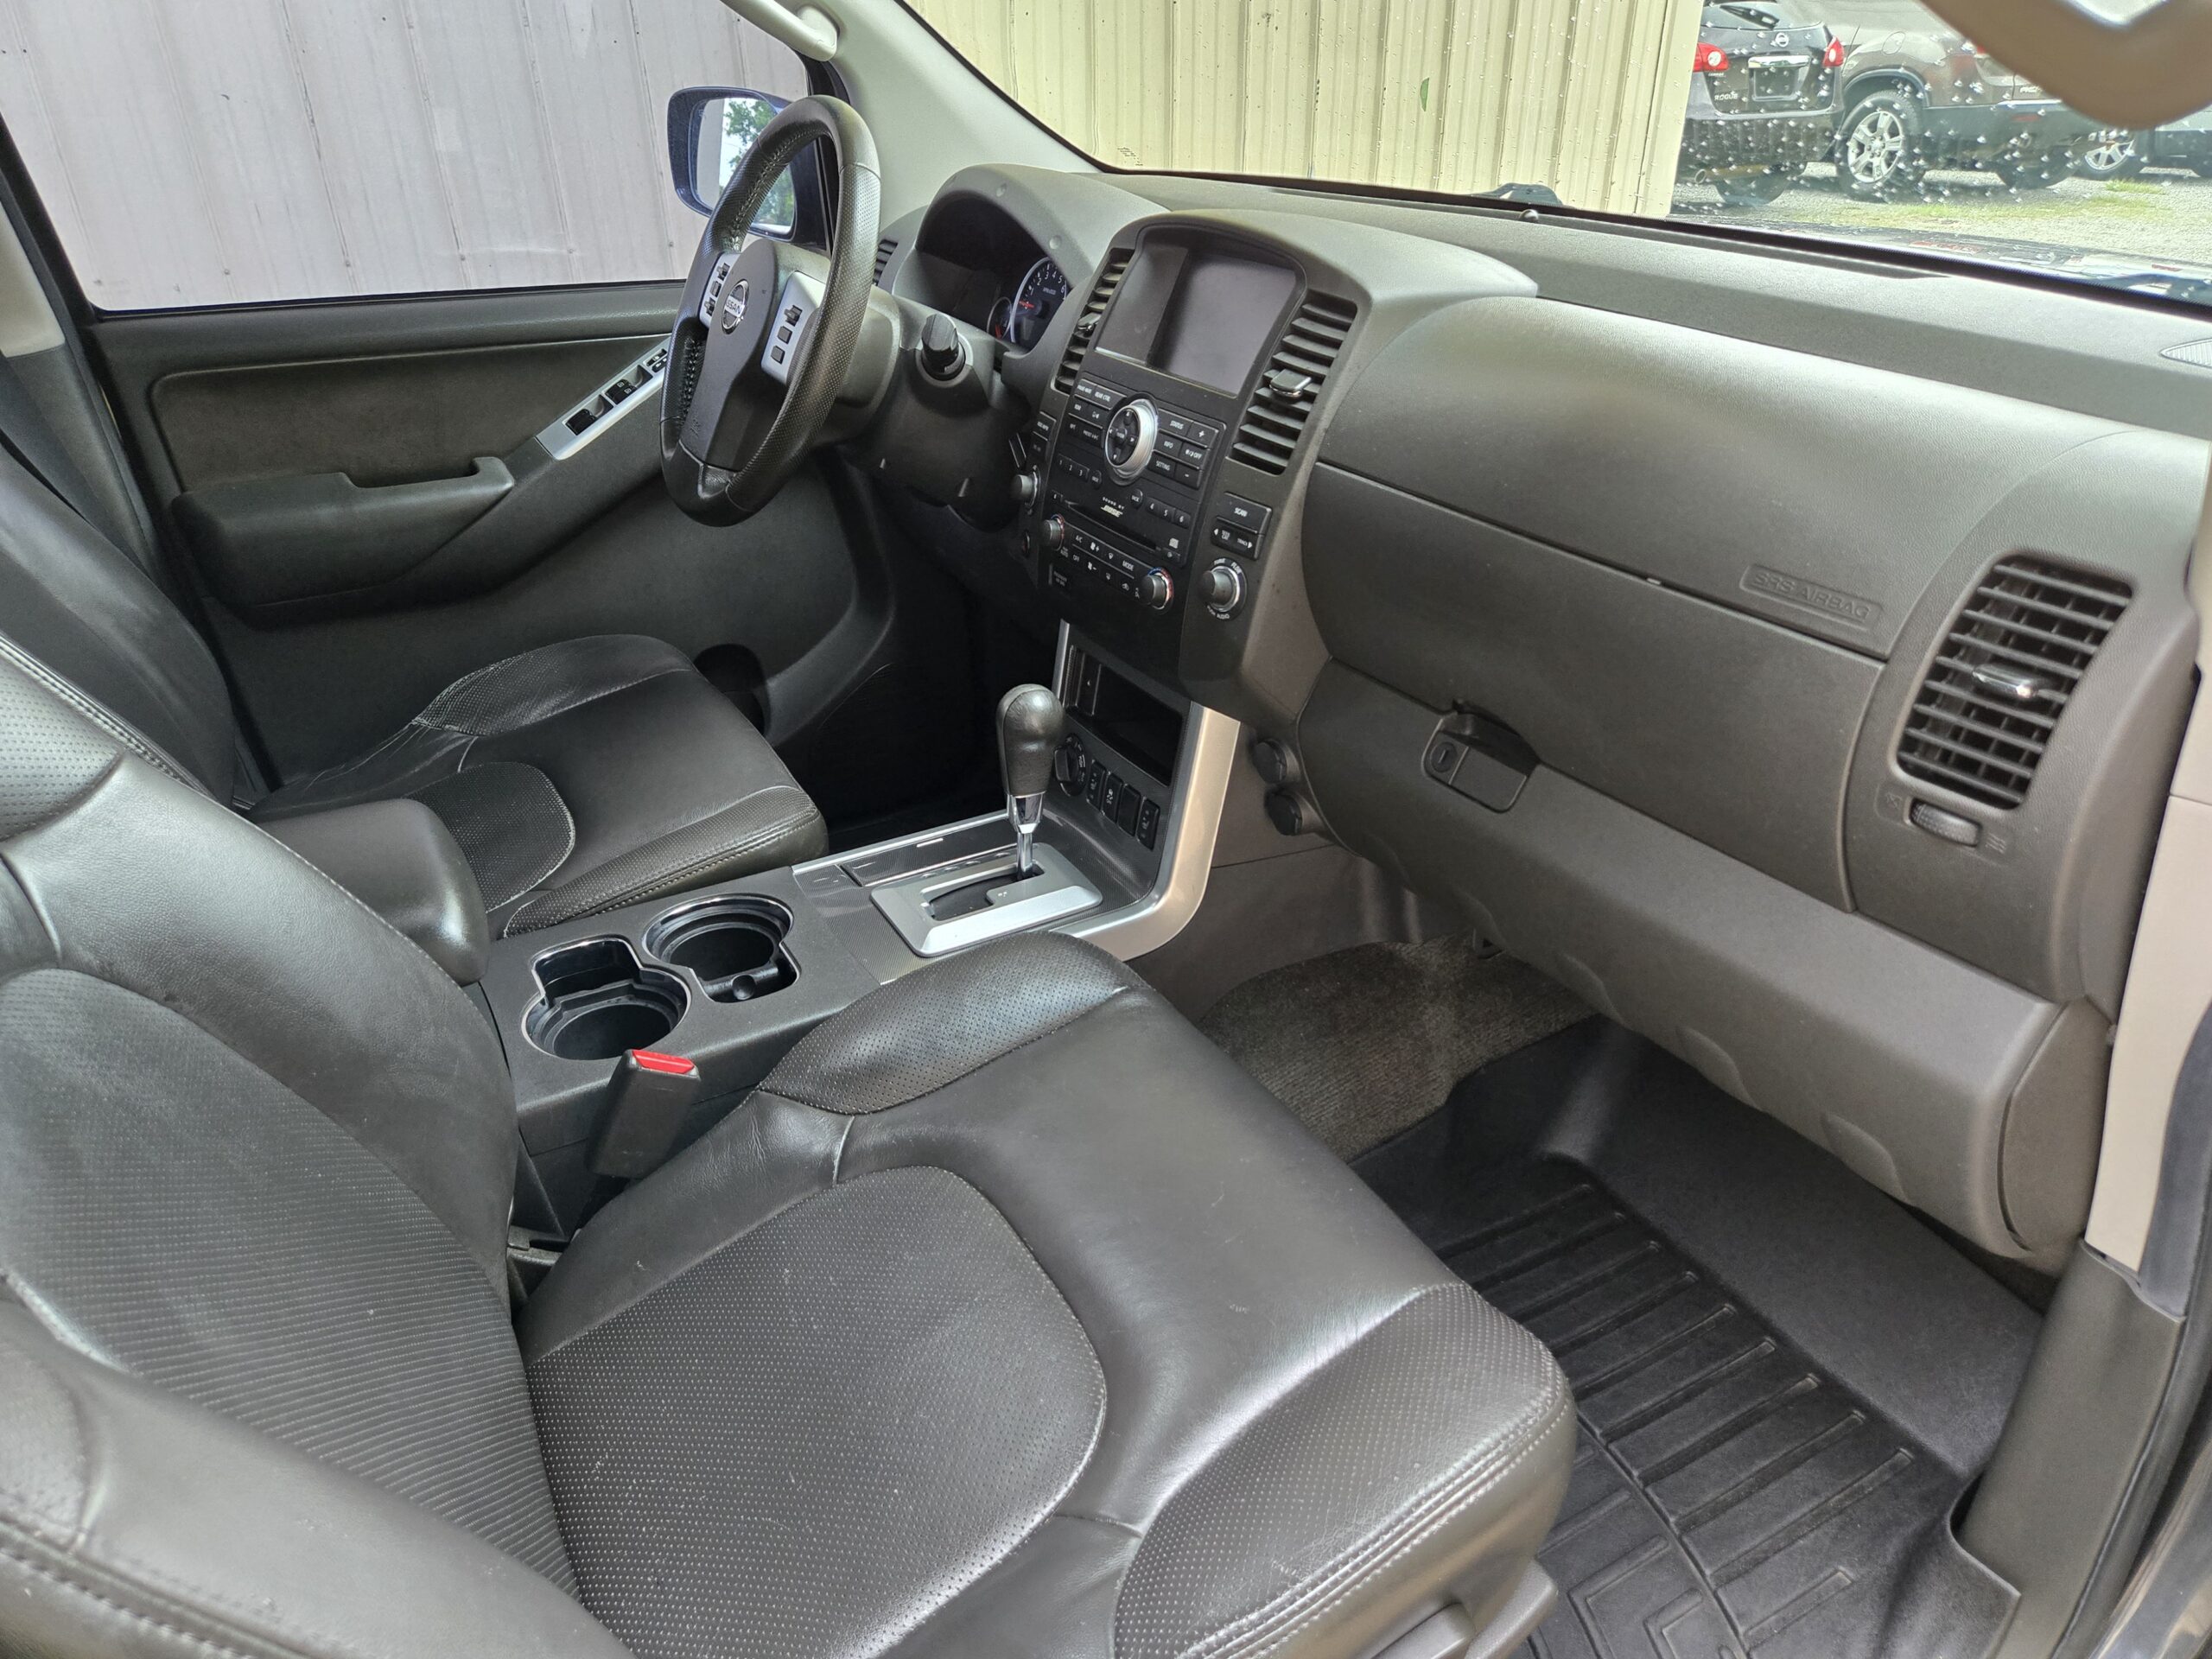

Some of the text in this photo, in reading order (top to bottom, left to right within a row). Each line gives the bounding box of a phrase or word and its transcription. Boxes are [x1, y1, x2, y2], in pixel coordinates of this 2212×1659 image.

[1714, 92, 1738, 101] ROGUE
[1101, 505, 1123, 518] BOSE
[1754, 570, 1872, 620] SRS AIRBAG
